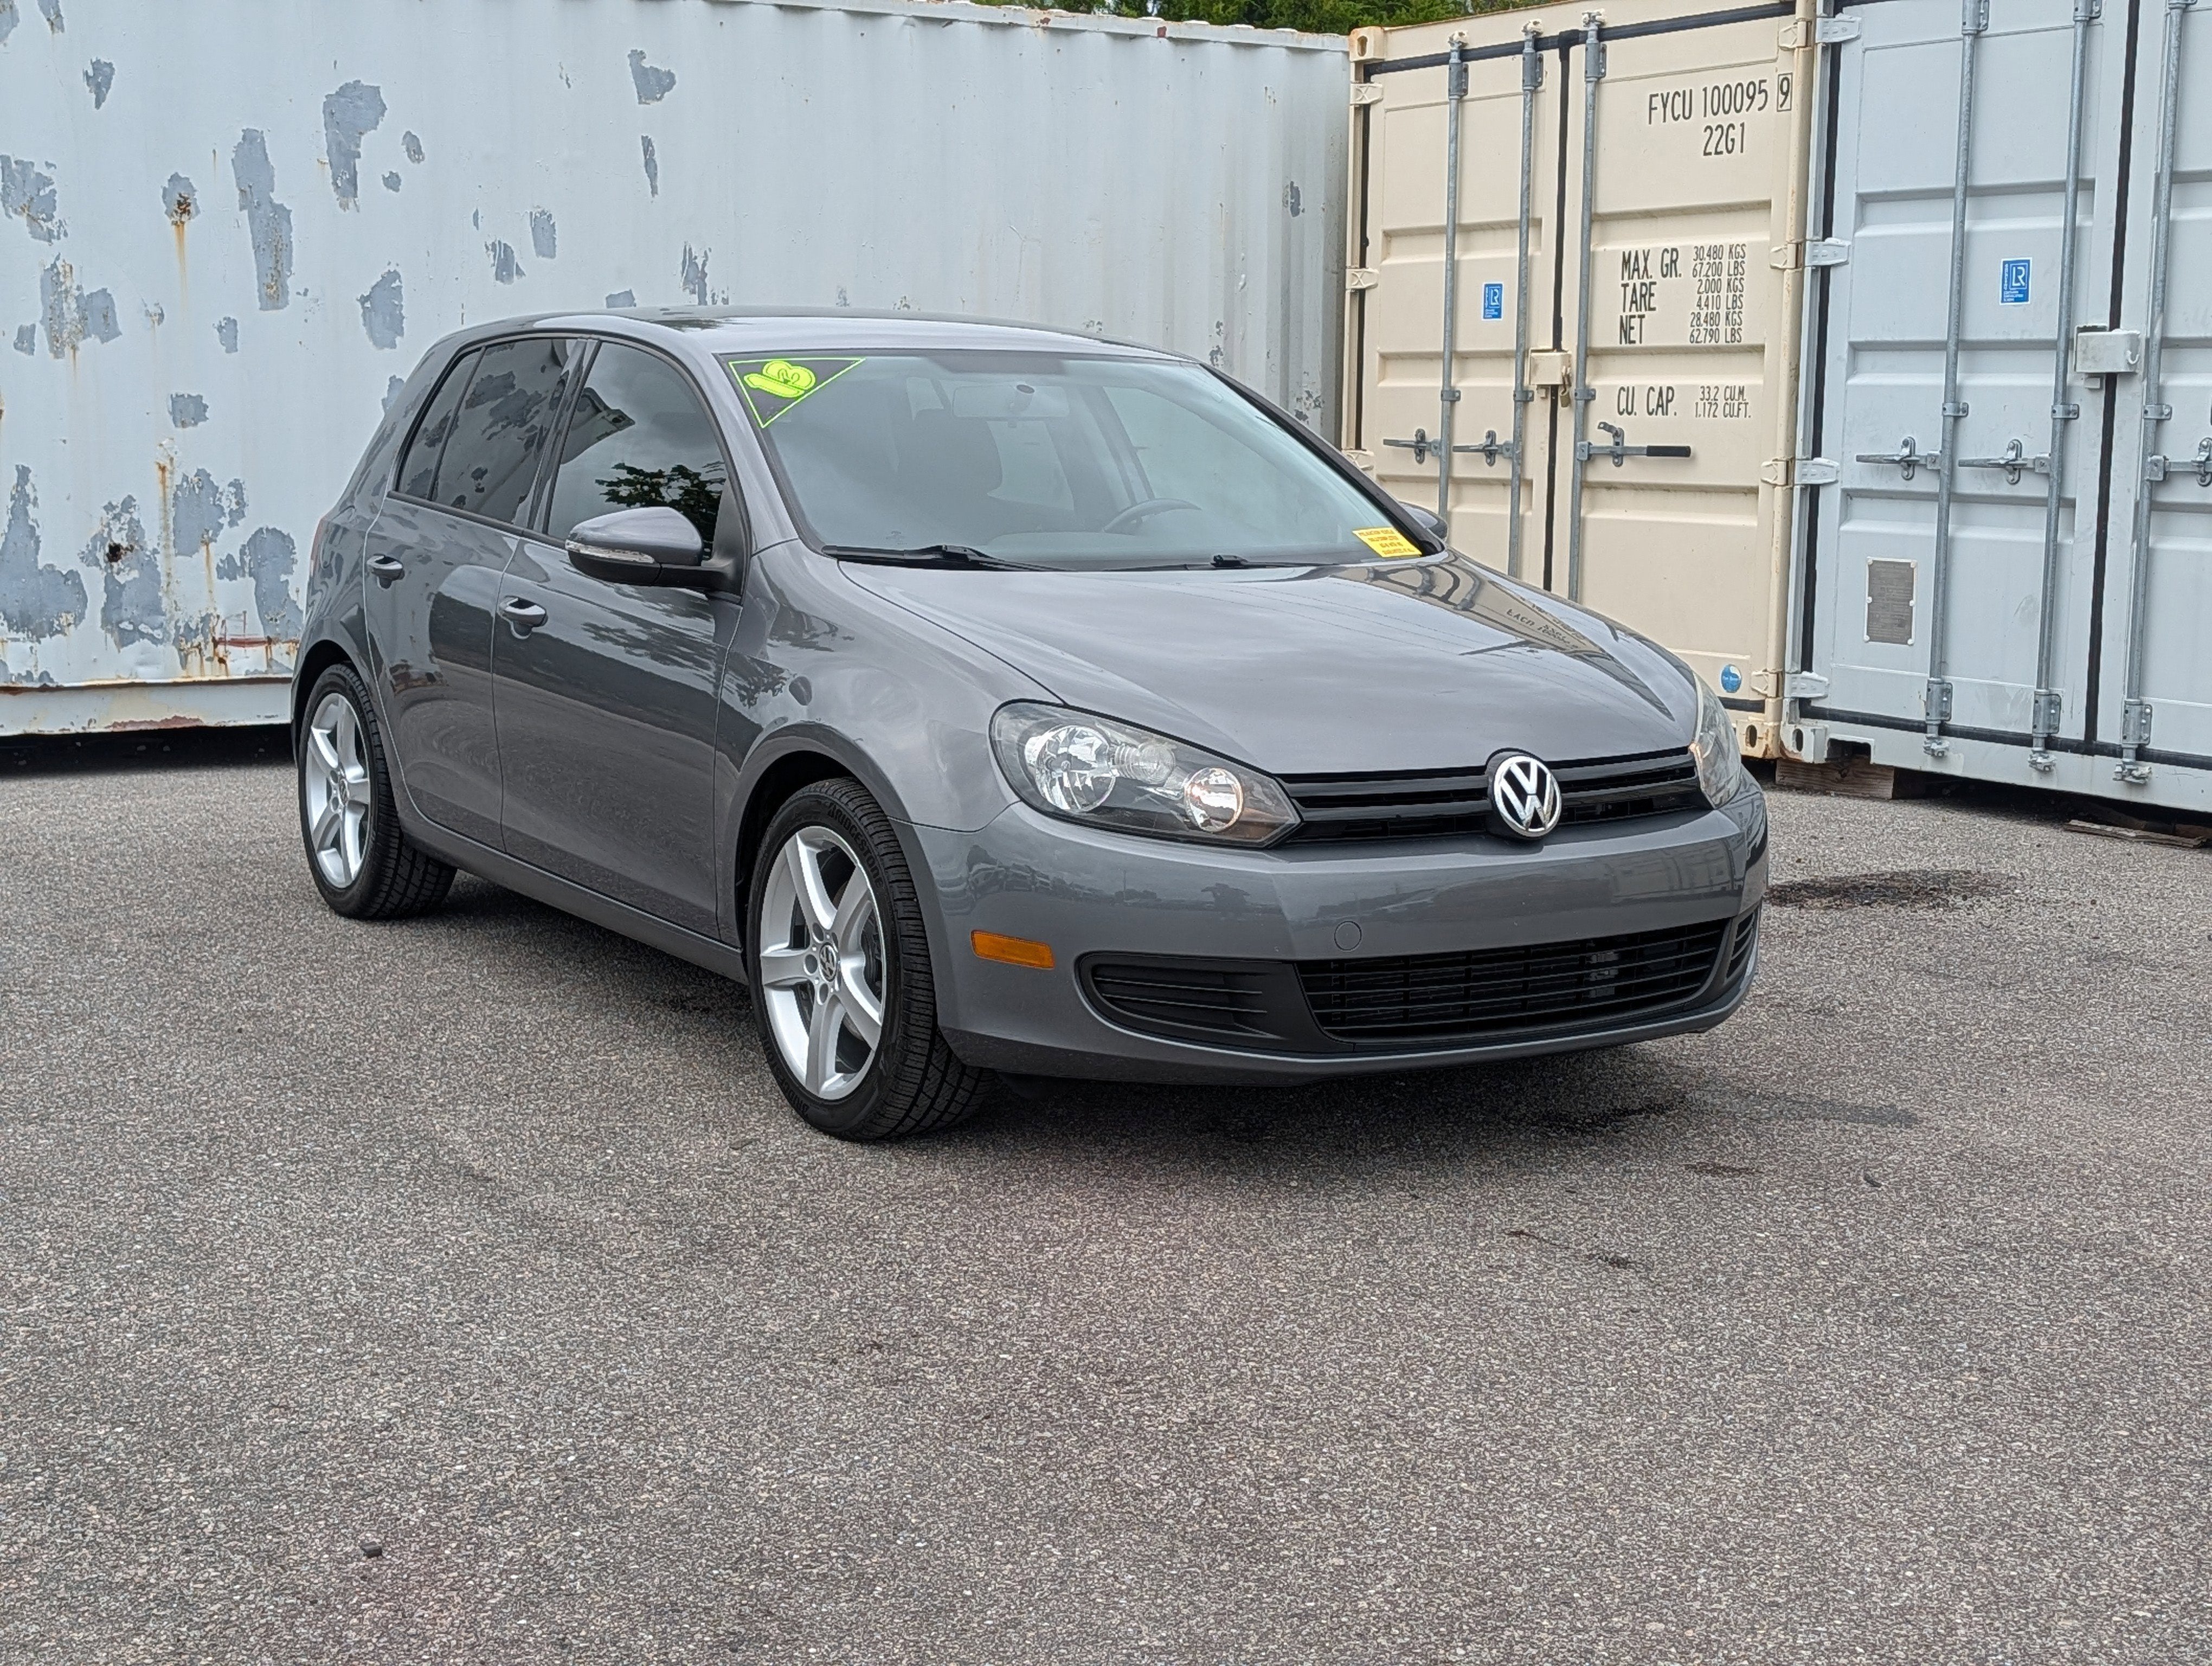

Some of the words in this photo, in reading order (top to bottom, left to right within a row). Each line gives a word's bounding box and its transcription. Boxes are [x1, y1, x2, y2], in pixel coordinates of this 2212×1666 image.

[1648, 88, 1693, 125] FYCU
[1702, 79, 1769, 118] 100095
[1779, 76, 1791, 108] 9
[1703, 122, 1746, 156] 22G1
[1621, 249, 1653, 281] MAX.
[1660, 247, 1682, 278] GR.
[1728, 244, 1747, 260] KGS
[1727, 260, 1746, 277] LBS
[2012, 266, 2025, 286] LR
[1621, 281, 1657, 312] TARE
[1726, 277, 1745, 293] KGS
[1726, 294, 1744, 310] LBS
[1619, 314, 1645, 345] NET
[1725, 311, 1743, 326] KGS
[1725, 327, 1742, 343] LBS
[1617, 386, 1637, 416] CU.
[1646, 386, 1677, 416] CAP.
[1700, 385, 1719, 401] 33.2
[1494, 755, 1562, 835] VW
[827, 802, 884, 888] BRIDGESTONE
